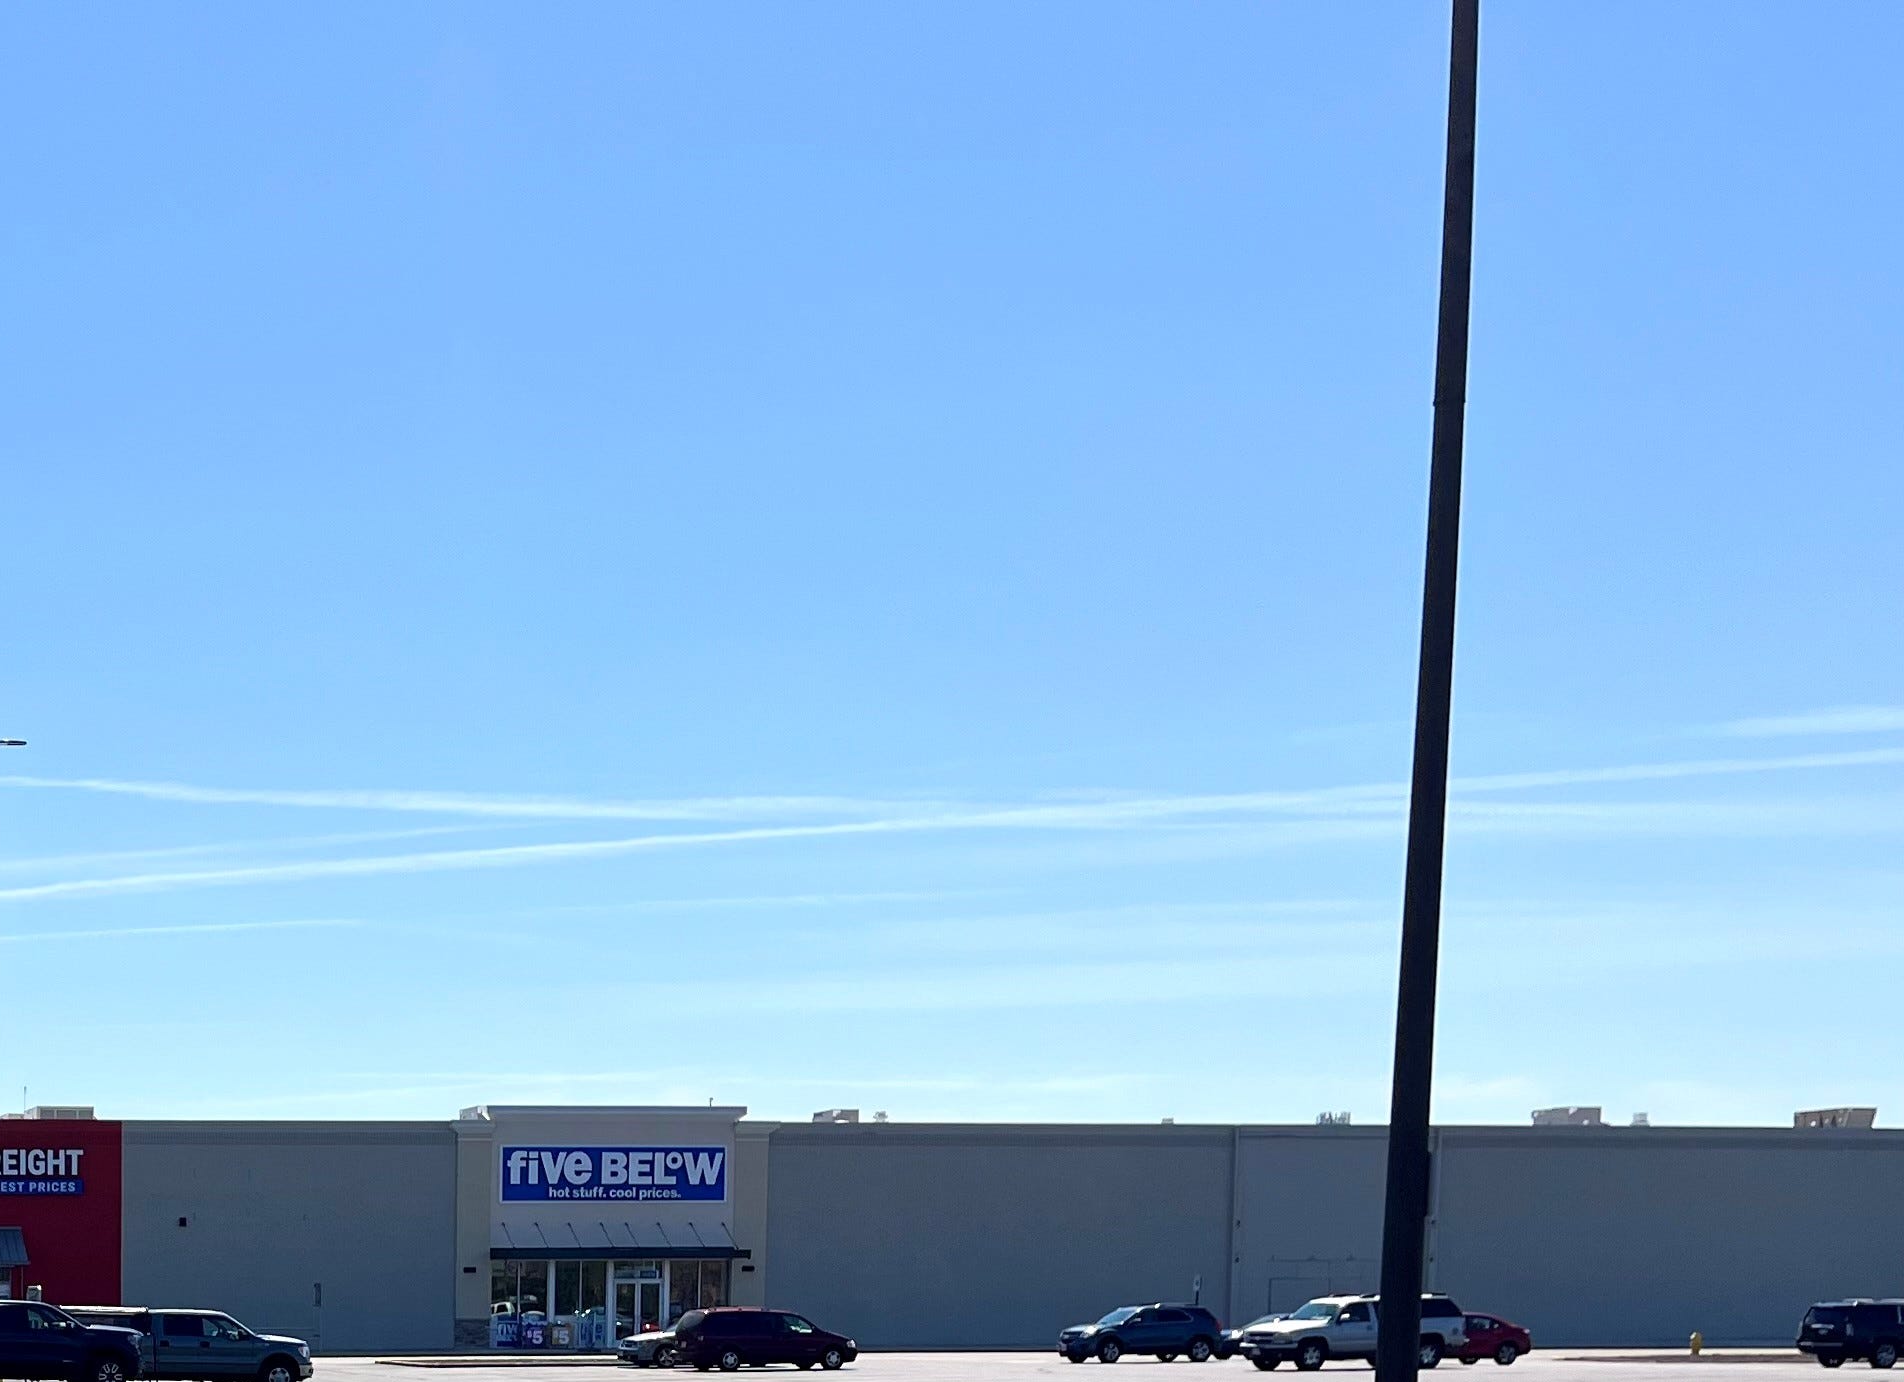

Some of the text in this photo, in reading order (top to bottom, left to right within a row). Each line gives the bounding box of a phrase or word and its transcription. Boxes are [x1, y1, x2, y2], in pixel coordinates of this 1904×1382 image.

[600, 1151, 724, 1185] BELOW
[28, 1181, 76, 1193] PRICES
[549, 1186, 570, 1198] hot
[572, 1186, 607, 1198] stuff.
[609, 1186, 636, 1198] cool
